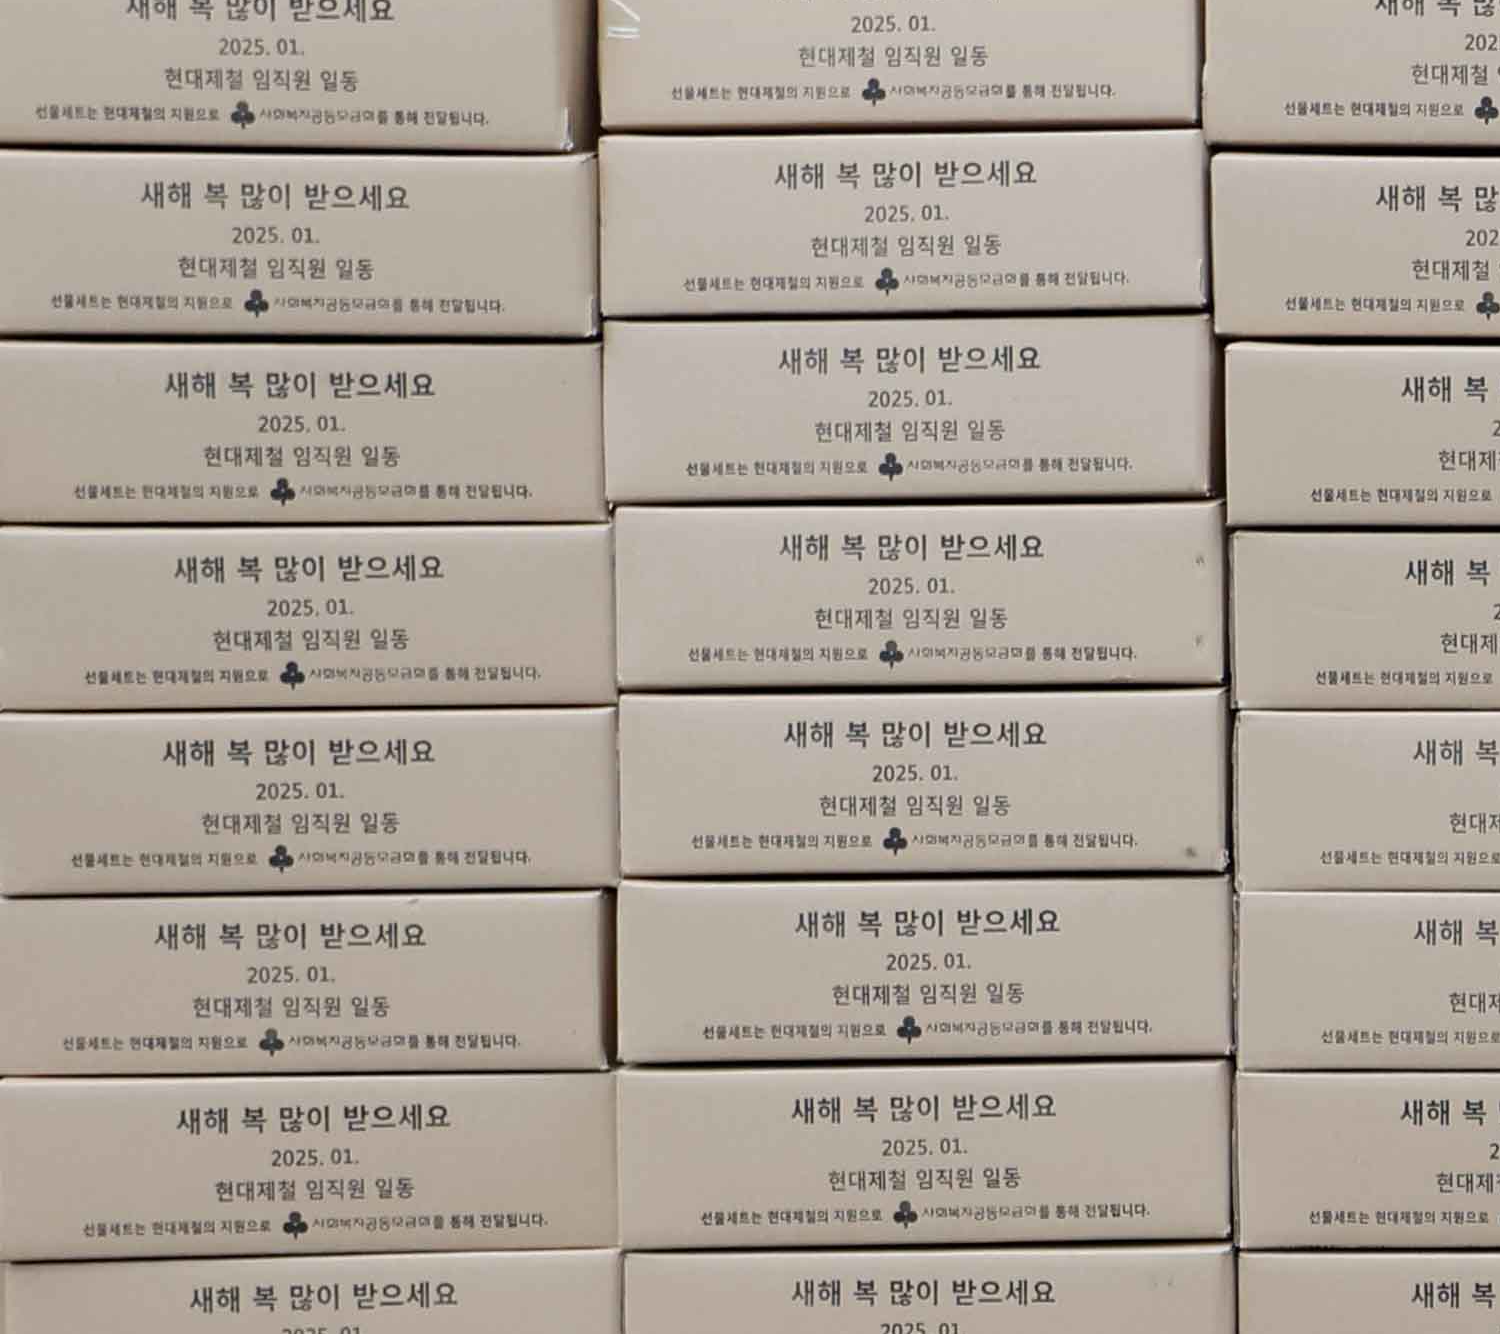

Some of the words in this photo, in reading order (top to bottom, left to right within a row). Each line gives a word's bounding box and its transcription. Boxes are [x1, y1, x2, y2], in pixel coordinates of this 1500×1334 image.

[219, 38, 270, 56] 2025.
[276, 38, 304, 56] 01.
[165, 67, 243, 91] 현대제철
[252, 69, 310, 91] 임직원
[320, 70, 358, 93] 일동
[35, 105, 97, 120] 선물세트는
[104, 106, 165, 122] 현대제철의
[171, 107, 219, 122] 지원으로
[394, 110, 419, 126] 통해
[424, 111, 488, 127] 전달됩니다.
[1376, 183, 1426, 212] 새해
[1438, 185, 1463, 213] 복
[1412, 258, 1490, 282] 현대제철
[1285, 296, 1345, 312] 선물세트는
[1351, 296, 1411, 314] 현대제철의
[1416, 299, 1464, 314] 지원으로
[779, 347, 828, 375] 새해
[840, 347, 864, 375] 복
[876, 343, 925, 374] 많이
[937, 344, 1041, 373] 받으세요
[868, 389, 919, 409] 2025.
[923, 389, 952, 409] 01.
[815, 419, 892, 443] 현대제철
[901, 419, 958, 443] 임직원
[968, 420, 1005, 441] 일동
[686, 461, 748, 478] 선물세트는
[754, 460, 815, 475] 현대제철의
[819, 459, 868, 475] 지원으로
[1038, 458, 1063, 472] 통해
[1067, 457, 1132, 473] 전달됩니다.
